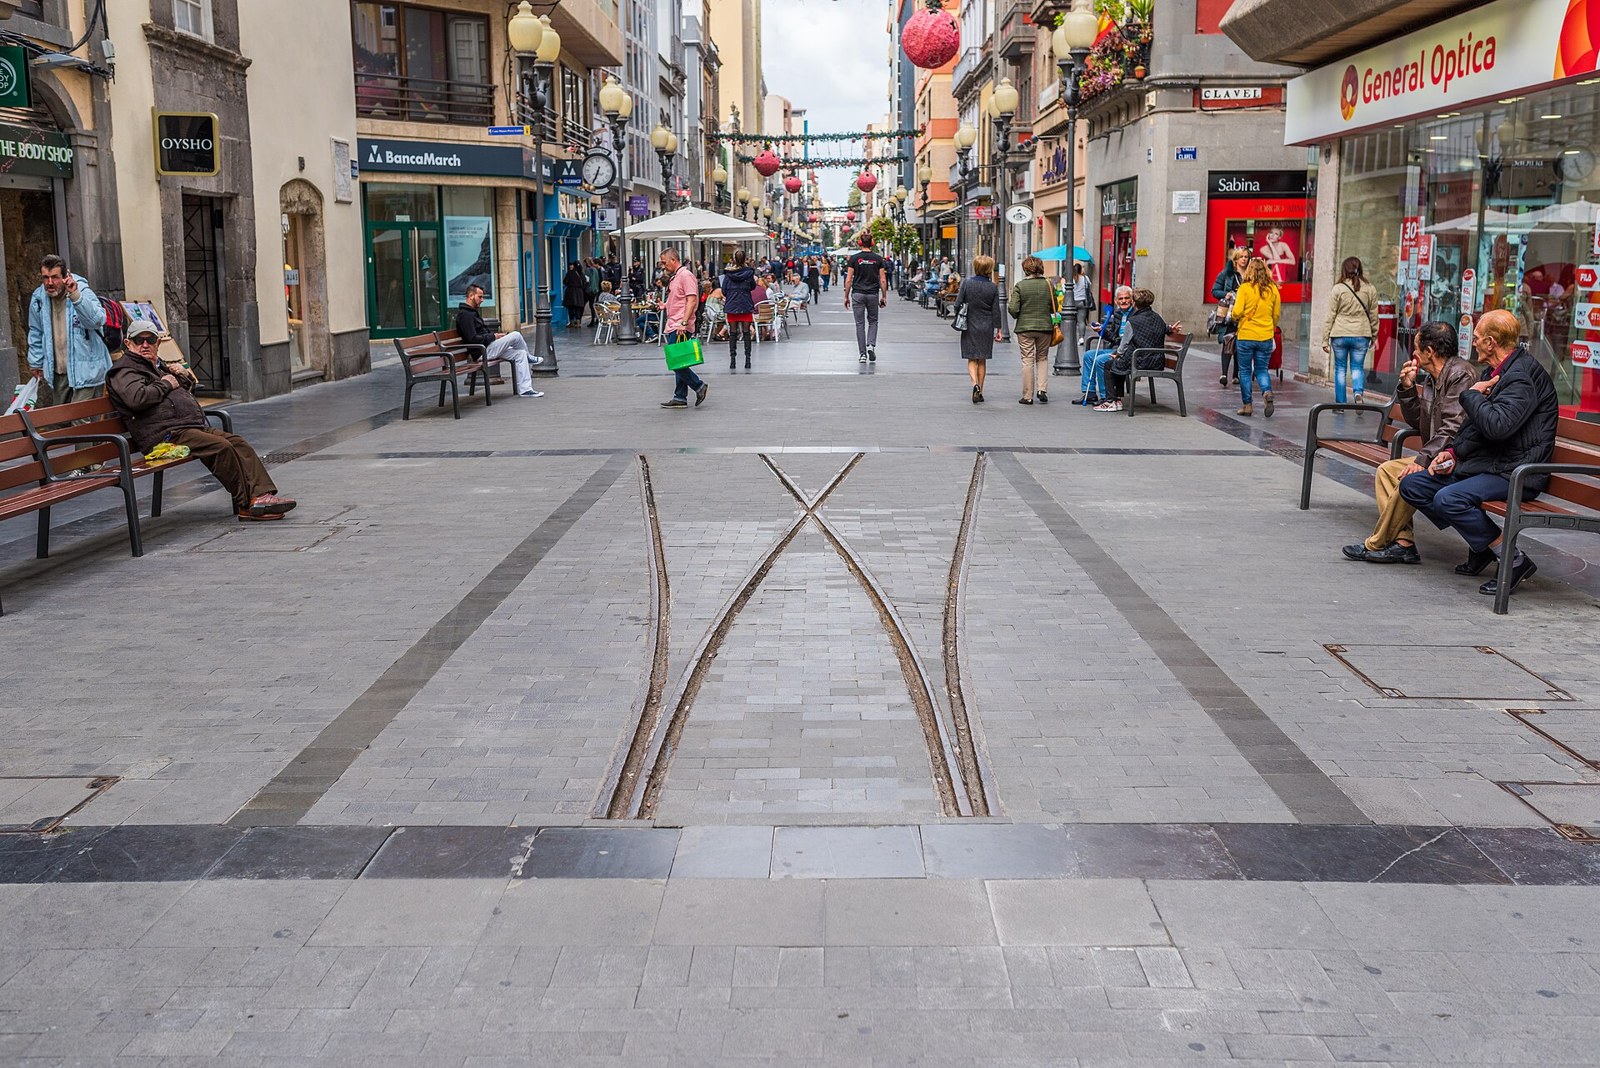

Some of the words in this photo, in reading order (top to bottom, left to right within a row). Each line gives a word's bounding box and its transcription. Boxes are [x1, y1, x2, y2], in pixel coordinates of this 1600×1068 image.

[1362, 50, 1425, 104] General
[1431, 31, 1496, 93] Optica
[1204, 89, 1260, 99] CLAVEL
[161, 137, 213, 150] OYSHO
[18, 141, 46, 160] BODY
[47, 145, 74, 163] SHOP
[385, 150, 461, 167] BancaMarch
[1218, 177, 1260, 192] Sabina
[1580, 273, 1592, 282] FILA
